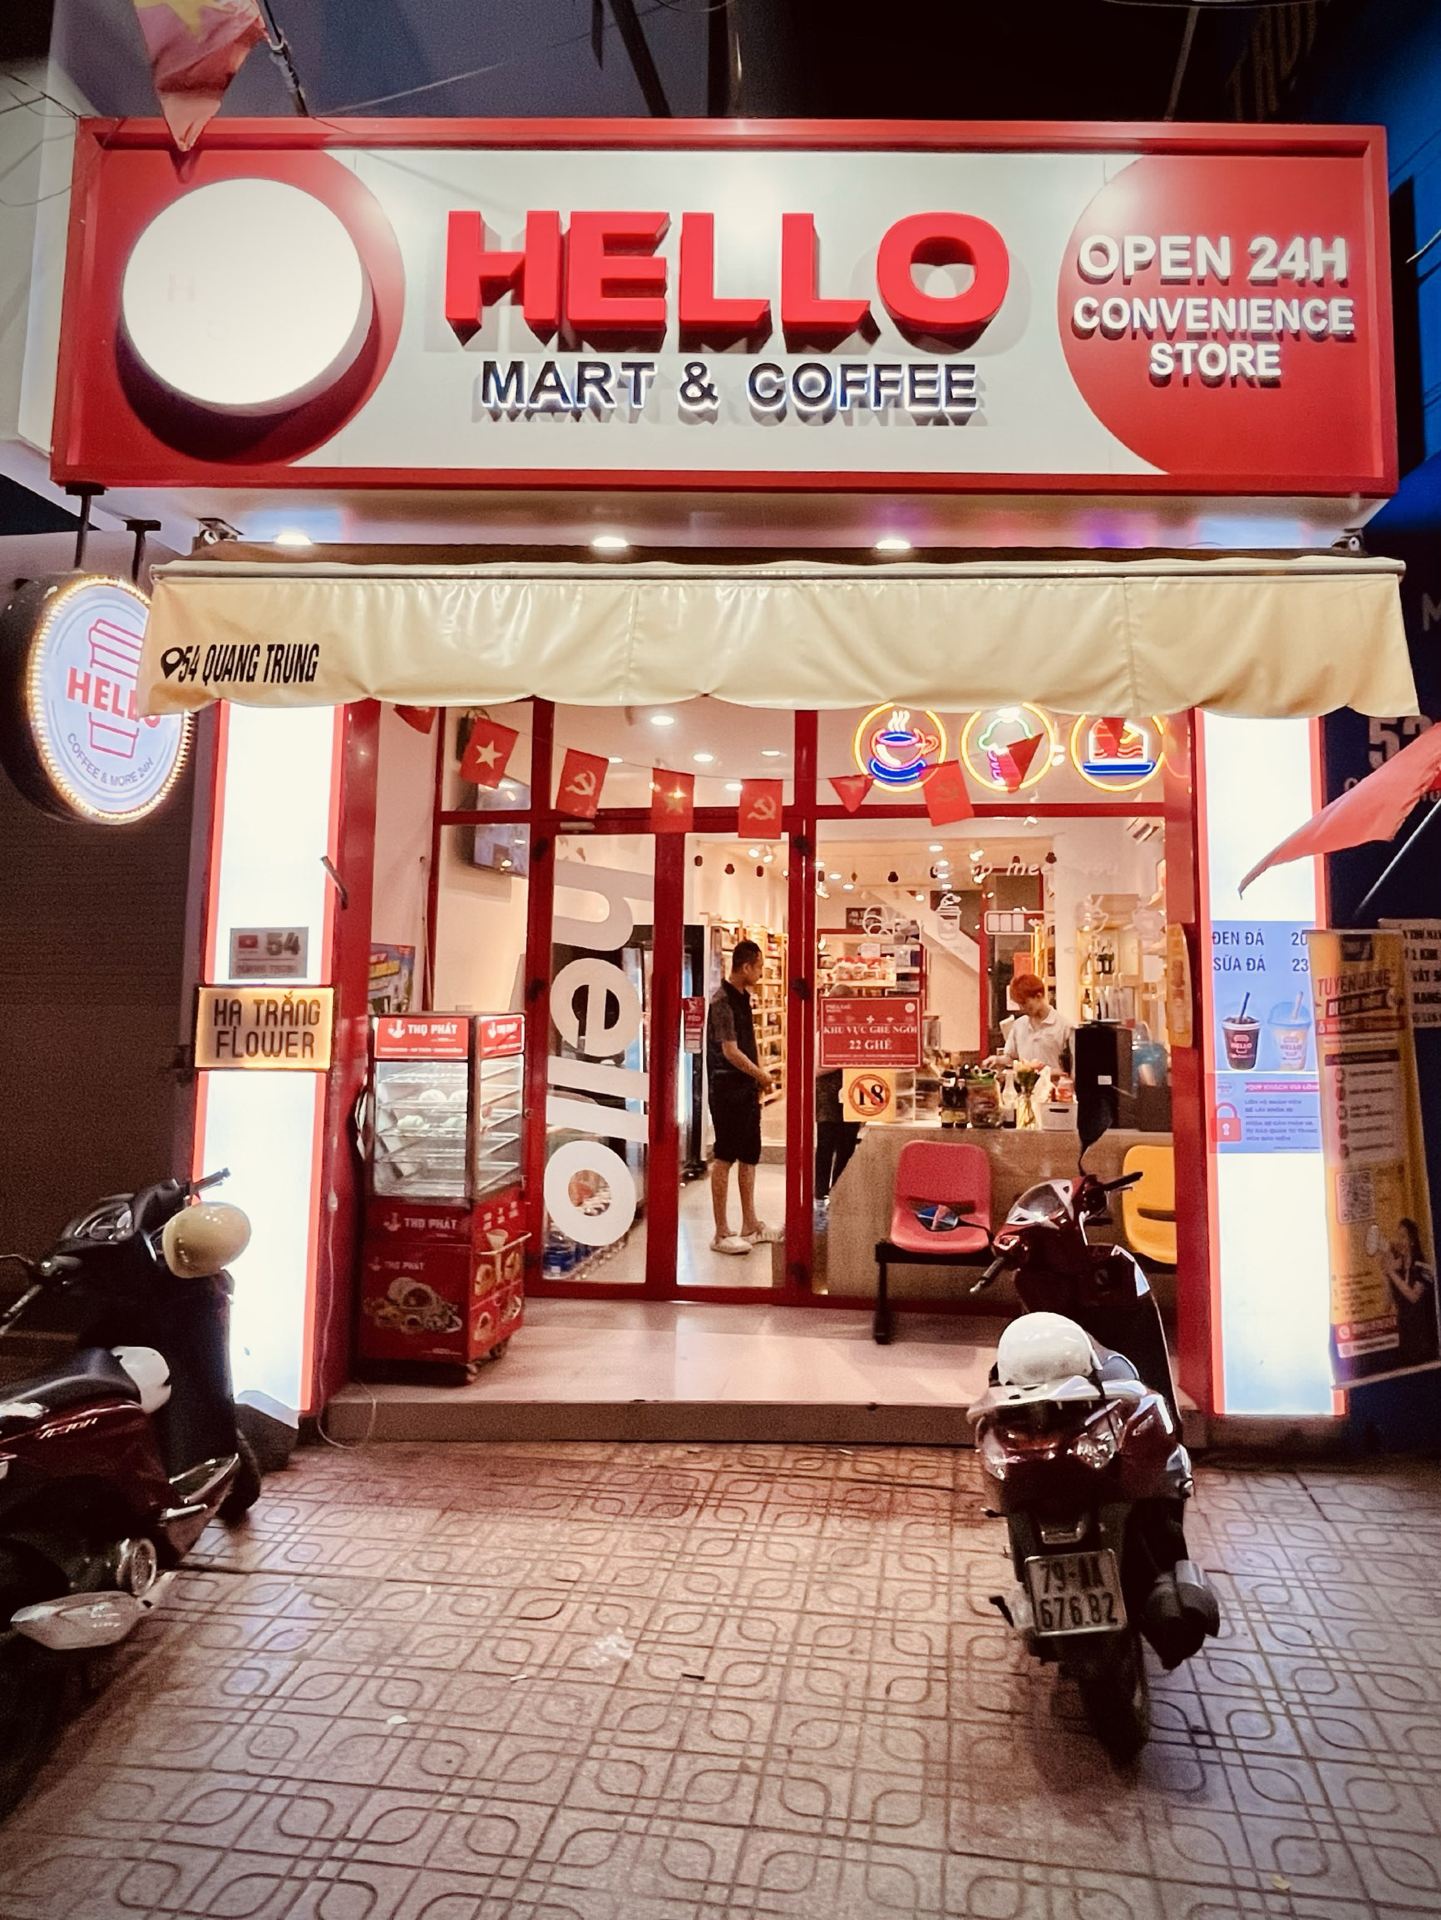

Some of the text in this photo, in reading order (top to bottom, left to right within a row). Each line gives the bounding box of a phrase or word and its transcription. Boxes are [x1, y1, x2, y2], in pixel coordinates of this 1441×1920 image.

[445, 210, 1011, 332] HELLO
[1078, 233, 1349, 282] OPEN 24H
[1072, 296, 1356, 334] CONVENIENCE
[1148, 341, 1283, 377] STORE
[480, 359, 979, 413] MART & COFFEE
[178, 642, 320, 687] 54 QUANG TRUNG
[67, 732, 101, 779] COFFEE
[267, 931, 301, 956] 54
[1211, 930, 1240, 946] ĐEN
[1244, 928, 1265, 946] ĐÁ
[1213, 953, 1309, 972] SỮA ĐÁ 23
[253, 990, 321, 1027] TRẮNG
[215, 1030, 315, 1059] FLOWER
[407, 1021, 458, 1037] THỌ PHÁT
[849, 1039, 862, 1050] 22
[543, 858, 656, 1248] hello
